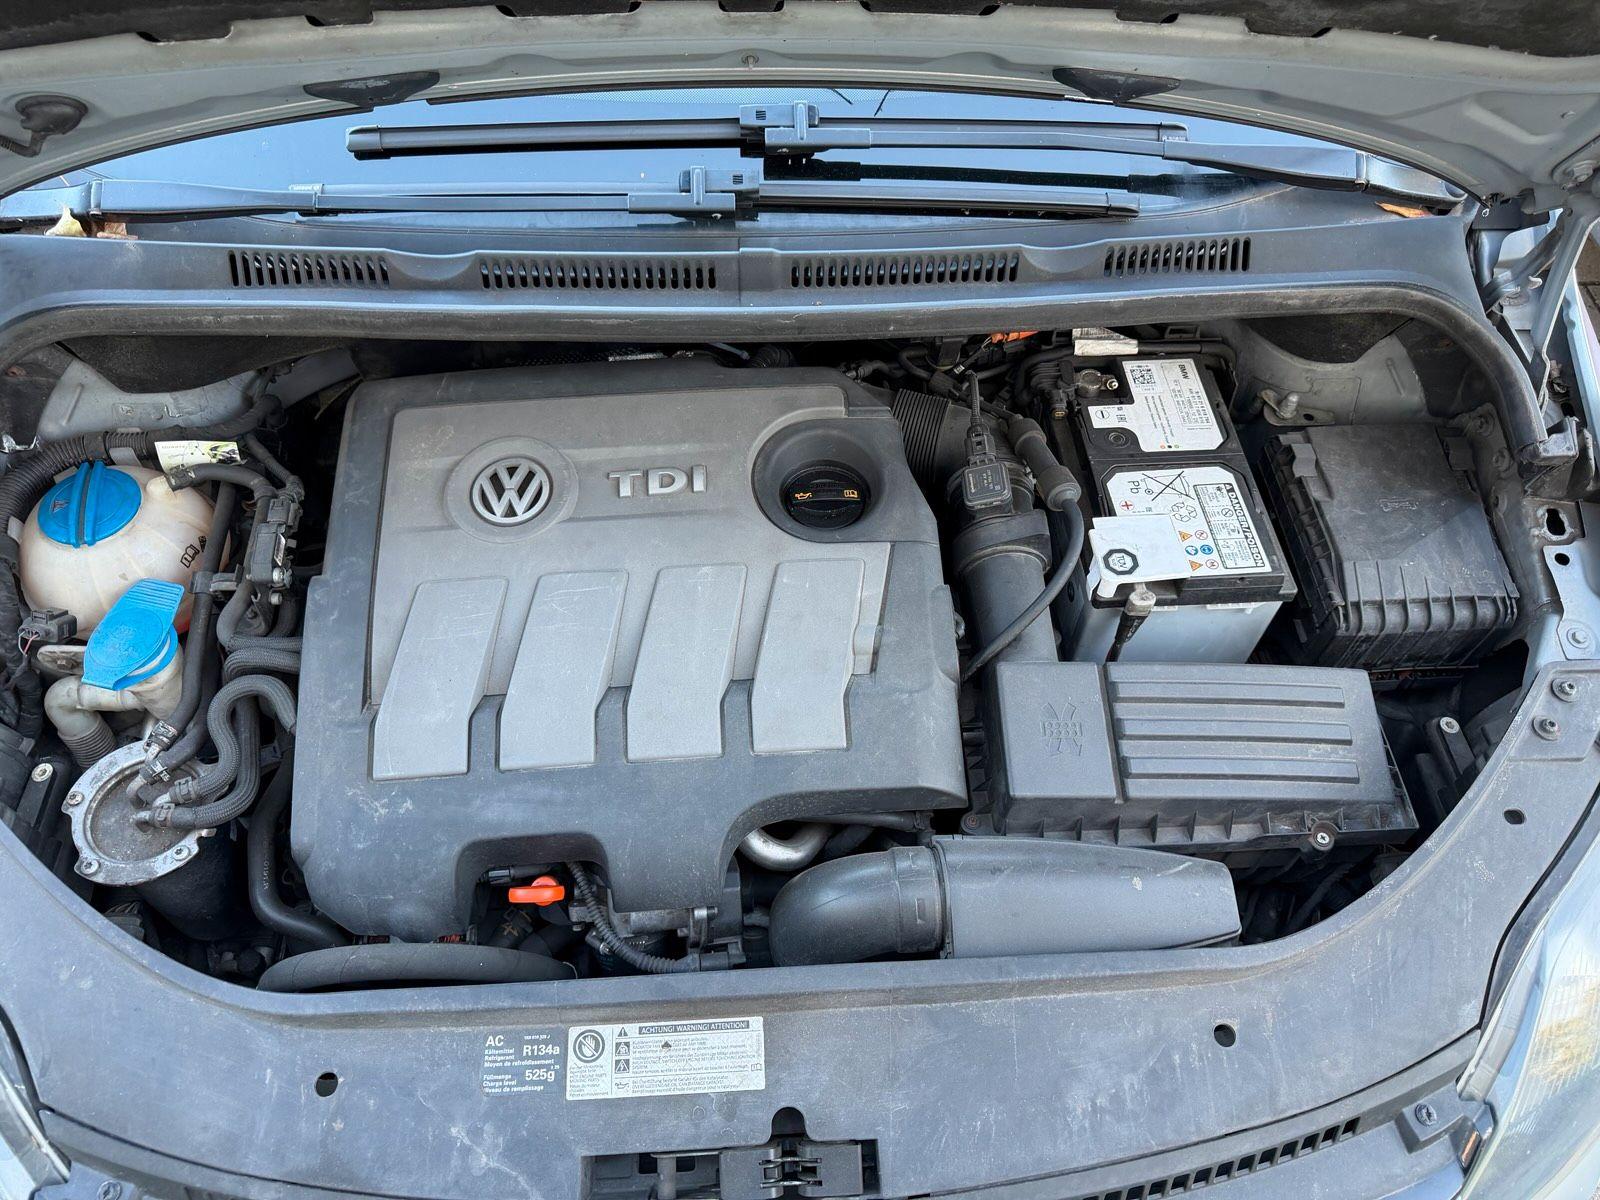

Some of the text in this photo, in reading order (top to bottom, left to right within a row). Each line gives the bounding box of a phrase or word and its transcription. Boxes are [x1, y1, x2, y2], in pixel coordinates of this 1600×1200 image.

[1179, 364, 1190, 379] BMW
[608, 465, 707, 498] TDI
[1127, 480, 1140, 494] Pb
[1227, 491, 1265, 567] DANGER/POISON
[642, 1021, 748, 1034] ACHTUNG! WARNING! ATTENTION!
[485, 1035, 504, 1047] AC
[523, 1044, 560, 1056] R134a
[525, 1069, 556, 1082] 525g
